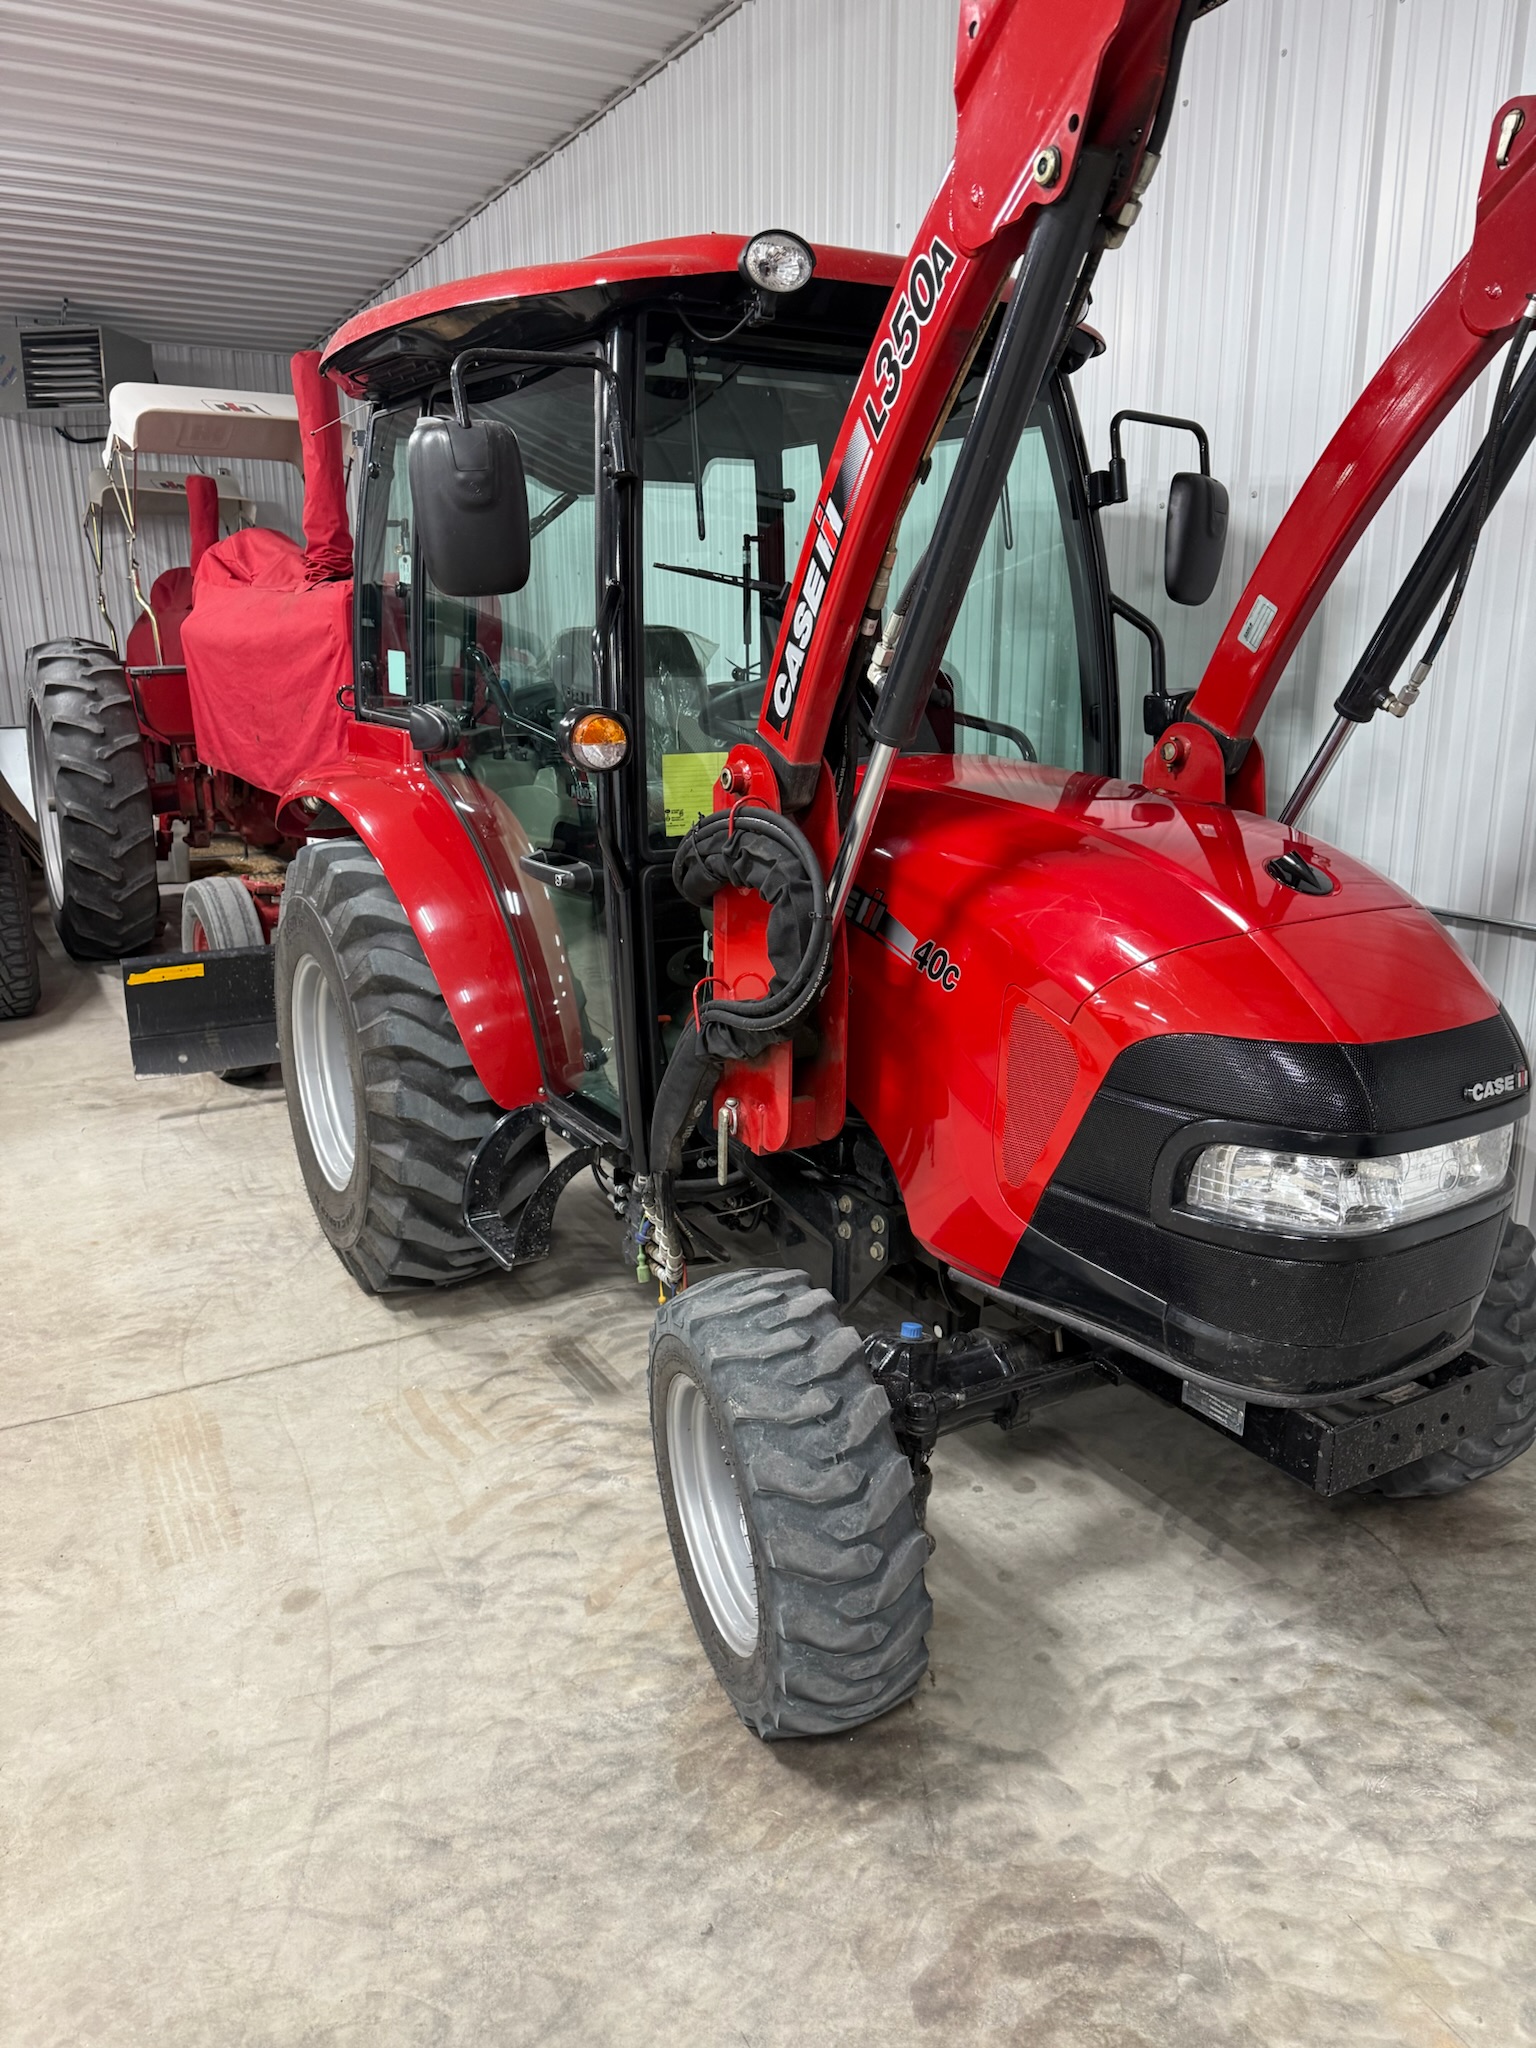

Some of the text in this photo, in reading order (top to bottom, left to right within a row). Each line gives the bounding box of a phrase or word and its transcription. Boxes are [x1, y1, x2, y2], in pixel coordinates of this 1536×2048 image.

[864, 235, 957, 444] L350A
[774, 557, 826, 719] CASE
[911, 939, 961, 992] 40C
[1472, 1074, 1515, 1102] CASE
